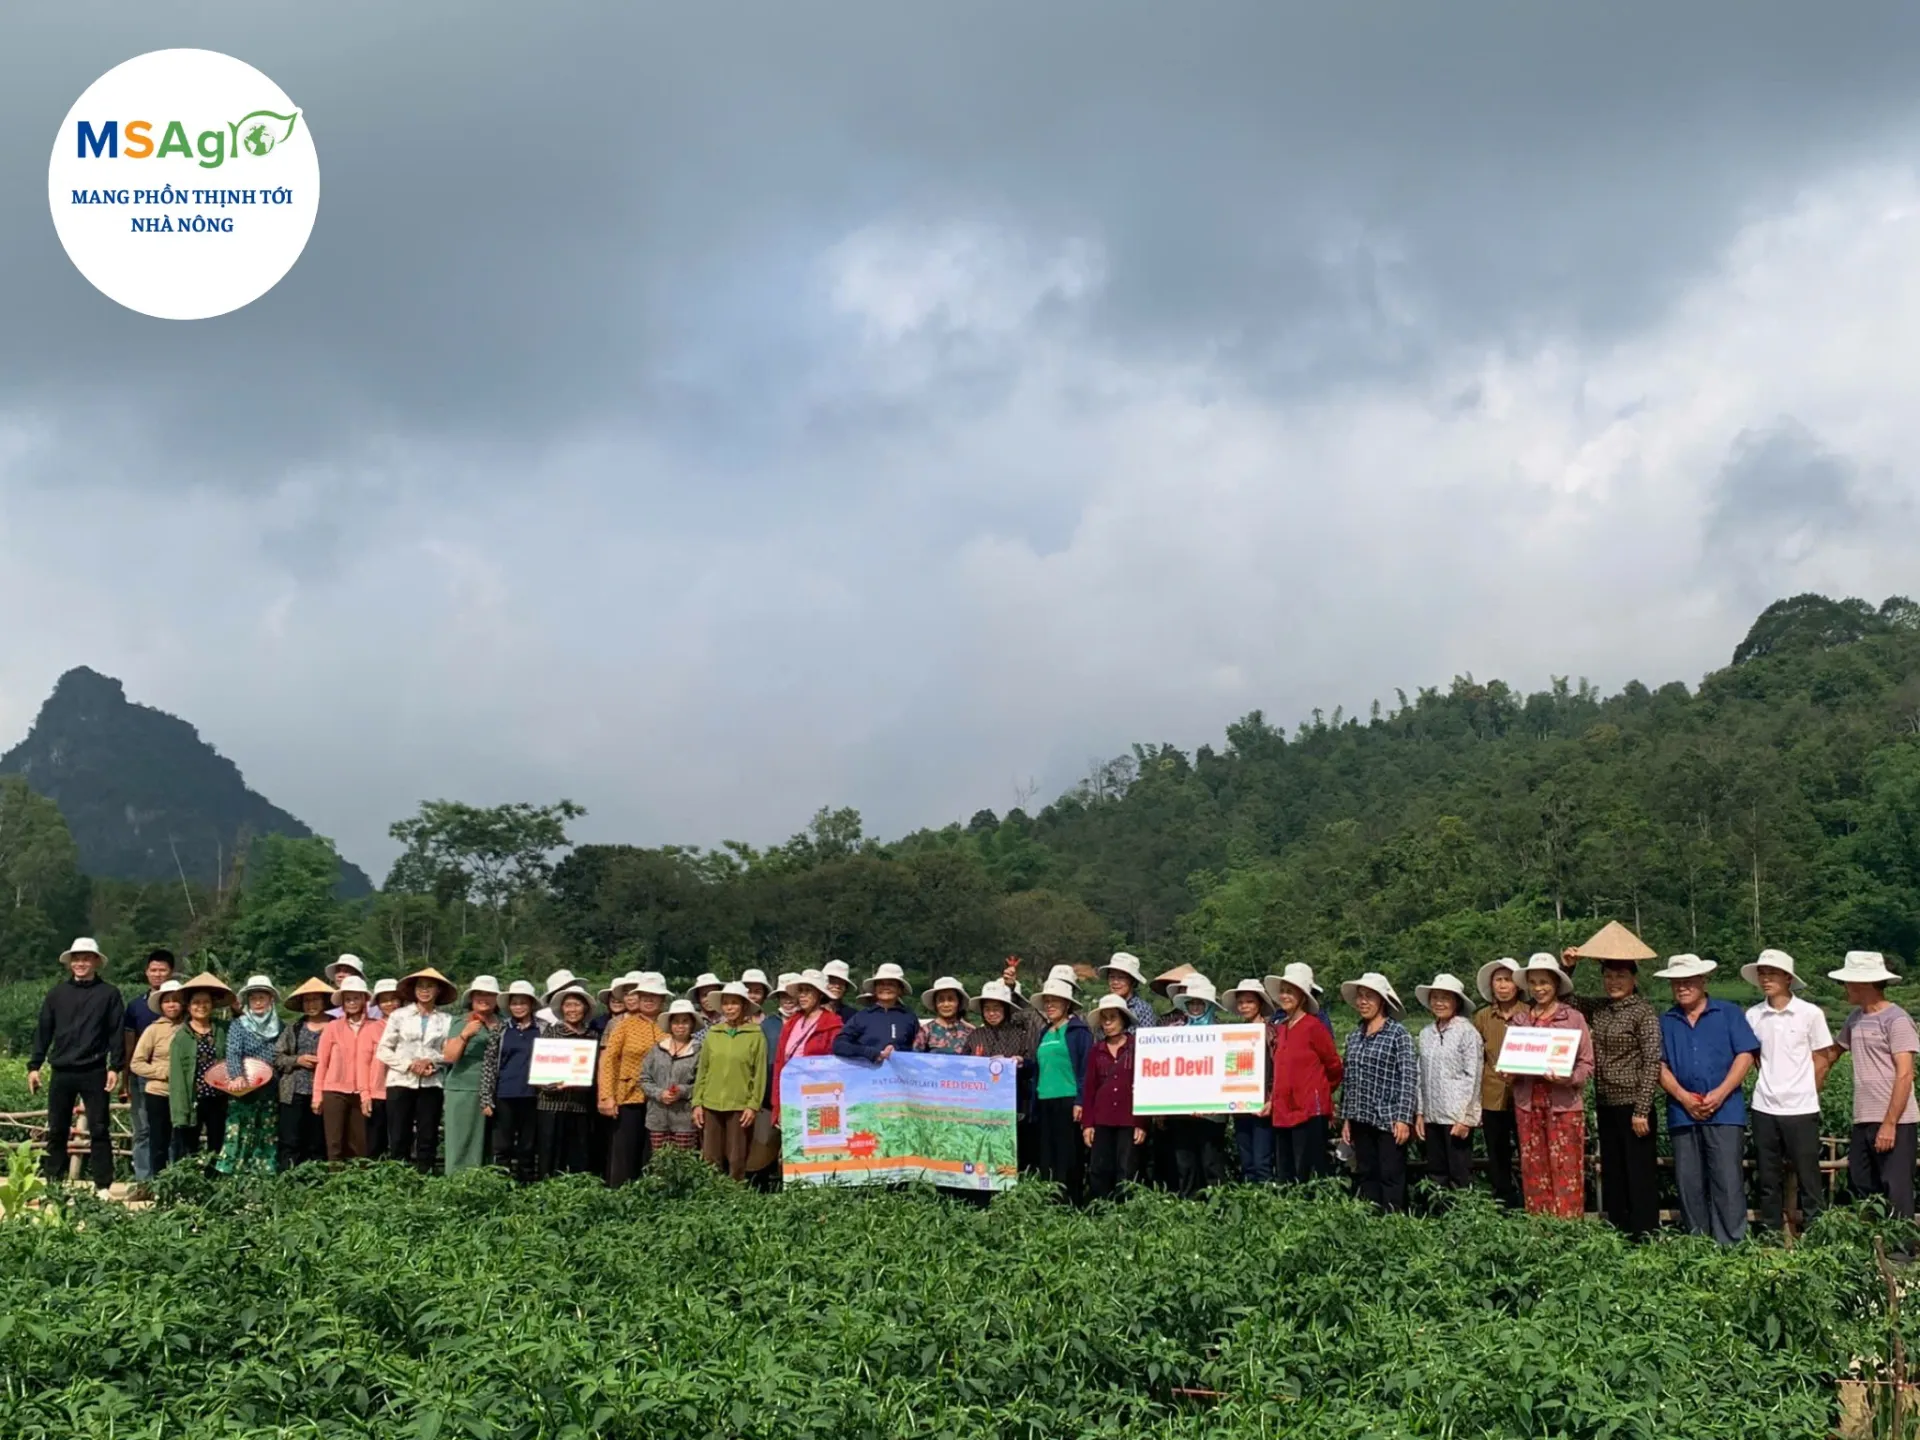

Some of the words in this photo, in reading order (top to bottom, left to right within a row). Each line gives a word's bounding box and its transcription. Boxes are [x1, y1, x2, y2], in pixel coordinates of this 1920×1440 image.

[1142, 1058, 1170, 1077] Red
[1175, 1056, 1214, 1076] Devil
[940, 1079, 959, 1089] RED
[961, 1081, 988, 1092] DEVIL
